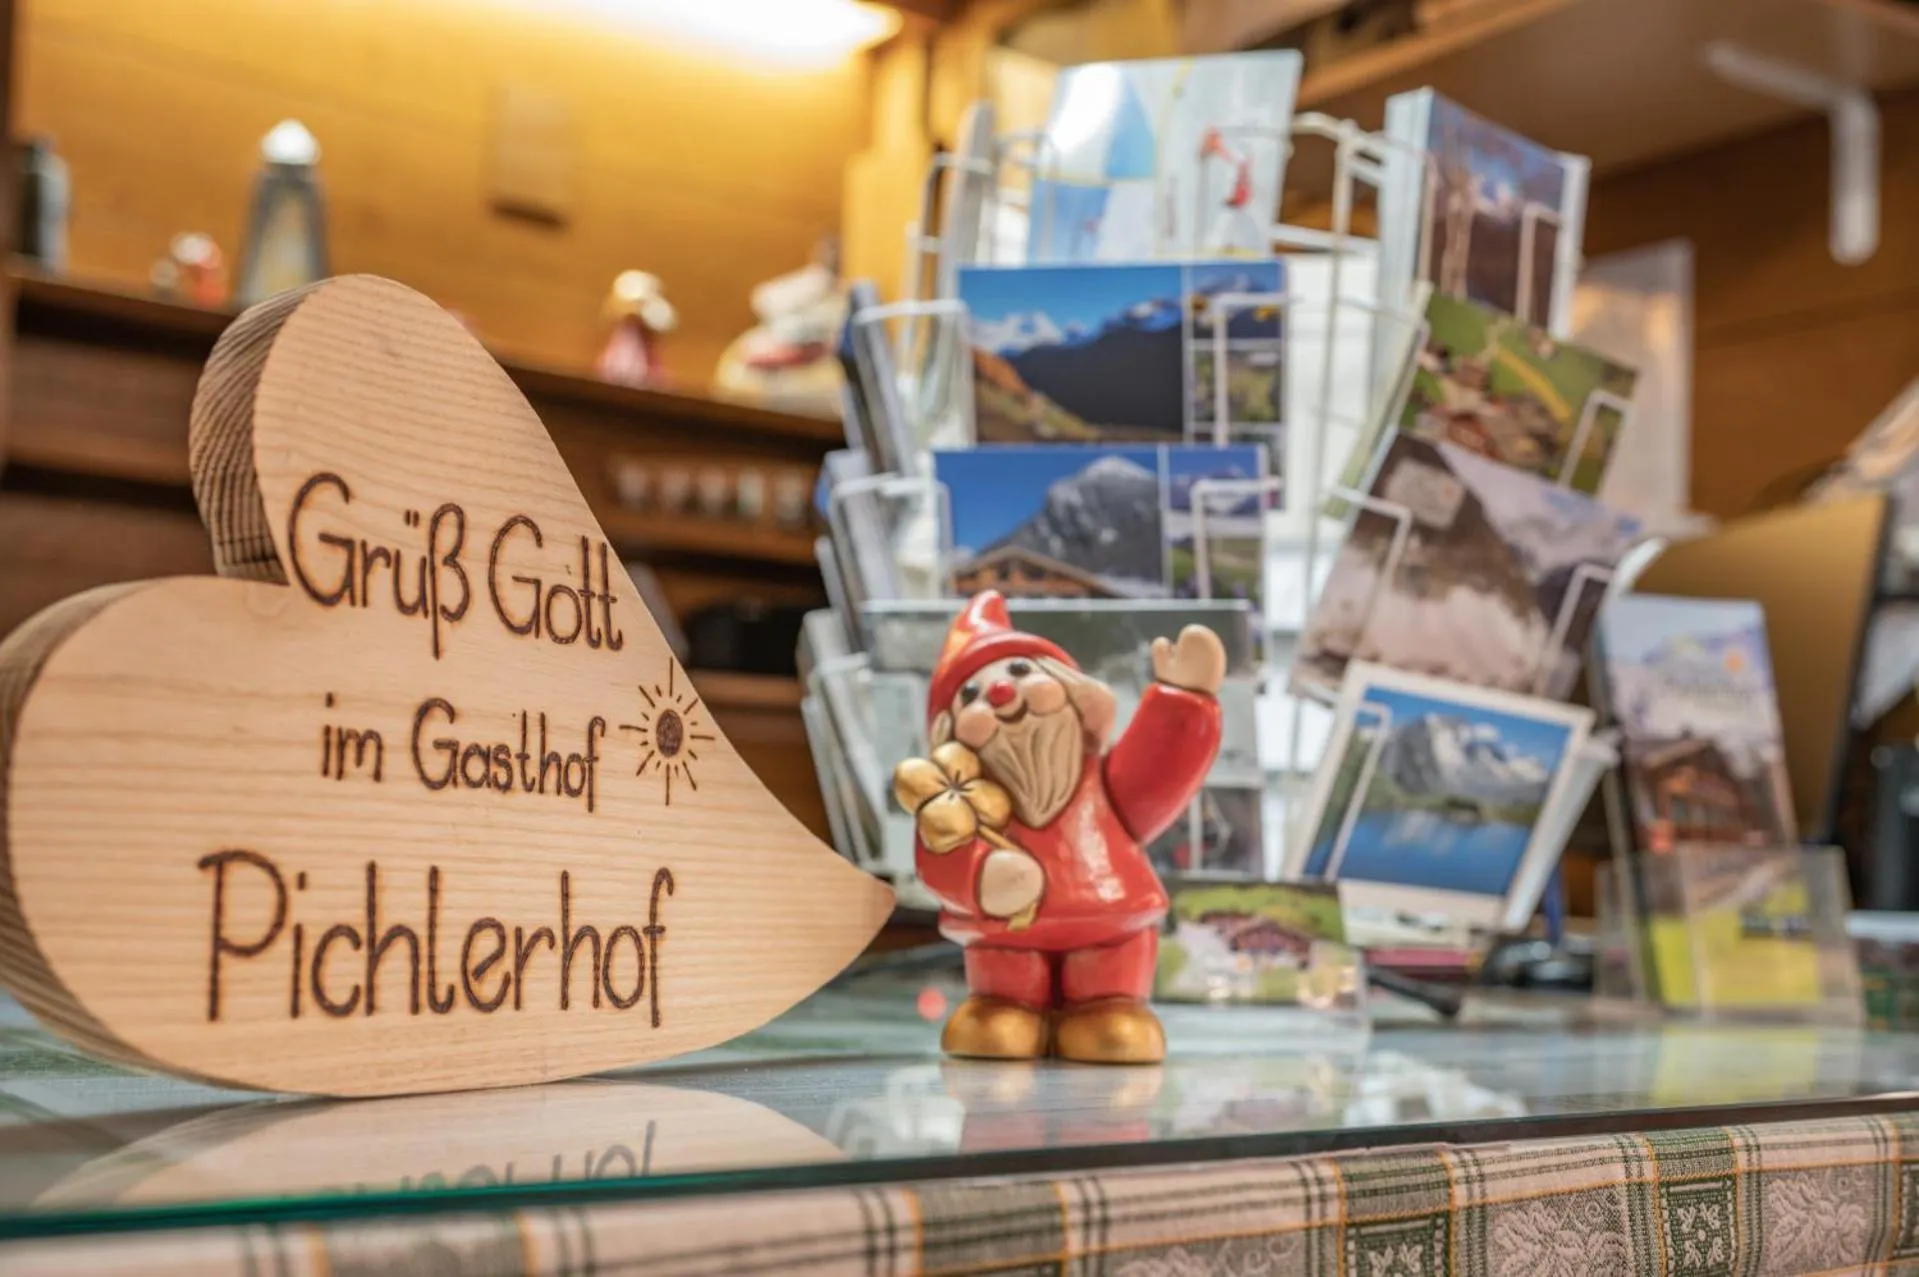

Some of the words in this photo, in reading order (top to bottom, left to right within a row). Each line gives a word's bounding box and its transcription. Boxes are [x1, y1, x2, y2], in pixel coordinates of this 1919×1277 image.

[288, 473, 470, 659] Grüß
[489, 515, 623, 651] Gott
[321, 693, 383, 782] im
[411, 698, 606, 812] Gasthof
[198, 850, 675, 1027] Pichlerhof
